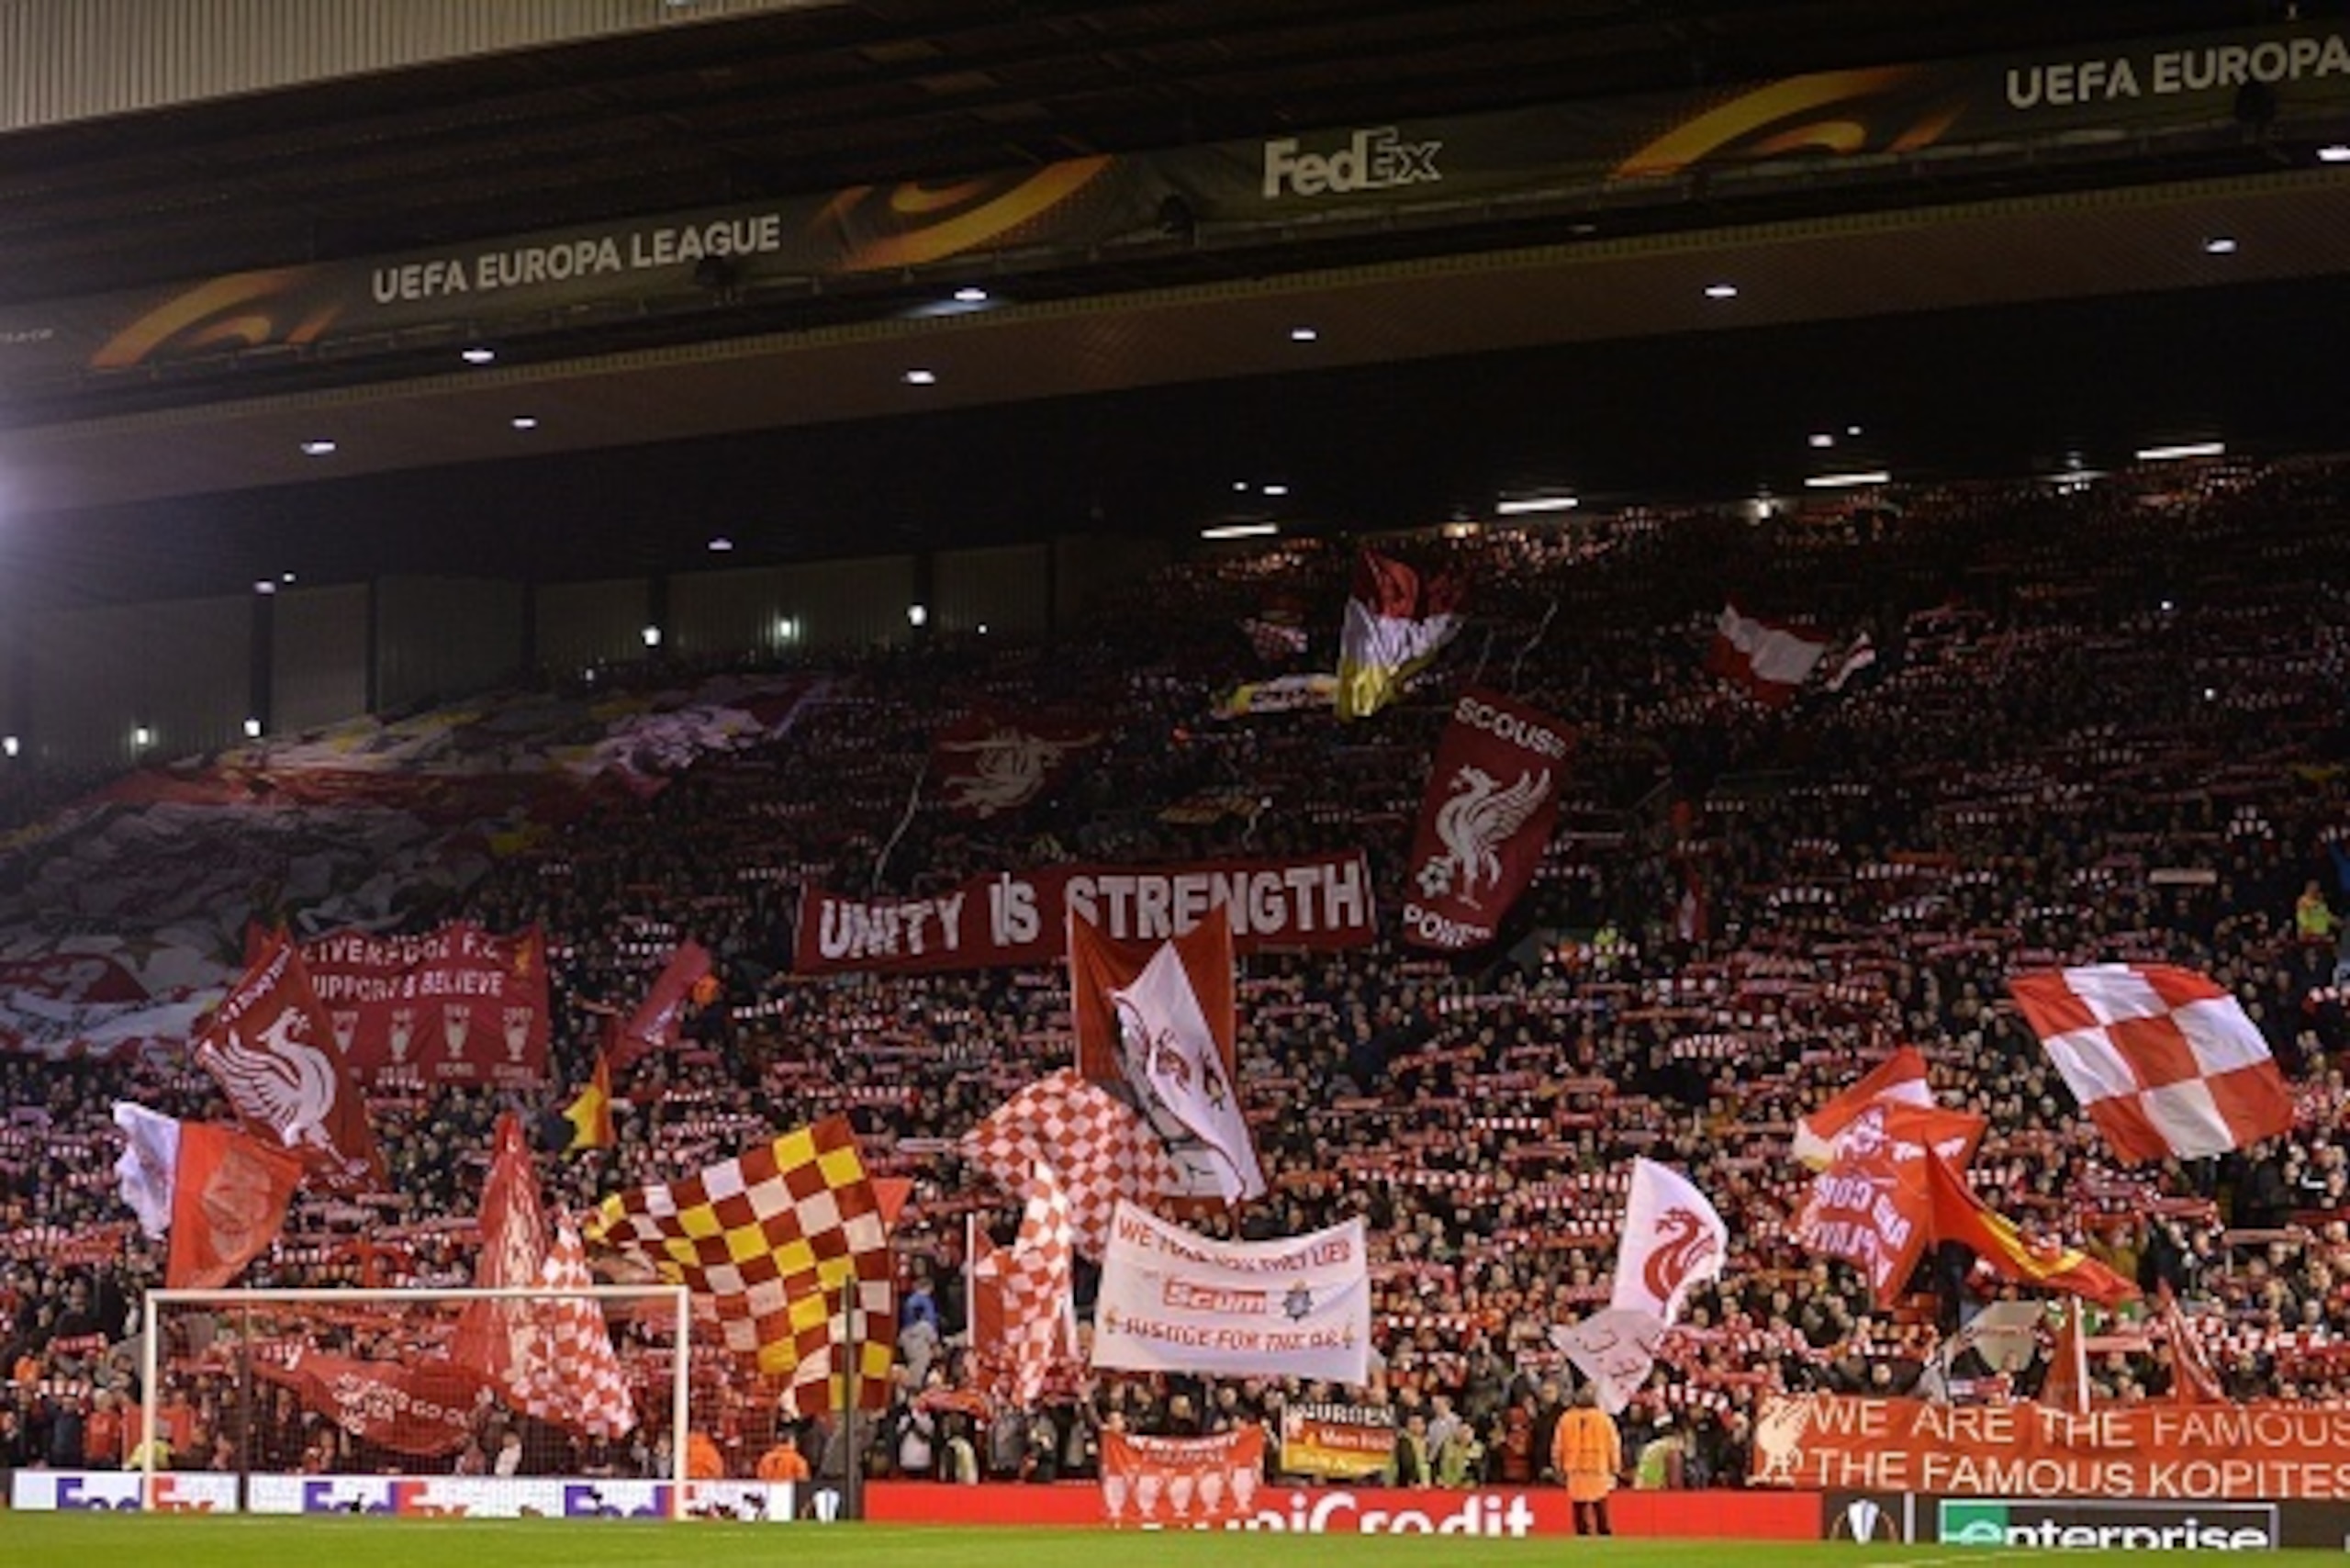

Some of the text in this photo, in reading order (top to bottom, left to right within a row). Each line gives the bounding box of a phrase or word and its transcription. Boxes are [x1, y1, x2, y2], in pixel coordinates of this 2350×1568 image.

[2006, 35, 2350, 109] UEFA EUROPA
[1264, 126, 1442, 198] FedEx
[374, 214, 780, 304] UEFA EUROPA LEAGUE
[819, 860, 1365, 959] UNITY IS STRENGTH
[312, 973, 400, 1002] UPPORT
[420, 969, 504, 997] BELIEVE
[1119, 1216, 1152, 1246] WE
[1125, 1316, 1210, 1347] JUSTICE
[1218, 1327, 1259, 1350] FOR
[1266, 1331, 1305, 1353] THE
[1810, 1400, 2350, 1448] WE ARE THE FAMOUS
[56, 1477, 215, 1512] FdE
[1809, 1447, 2350, 1499] THE FAMOUS KOPITES
[1226, 1492, 1534, 1537] niCredit
